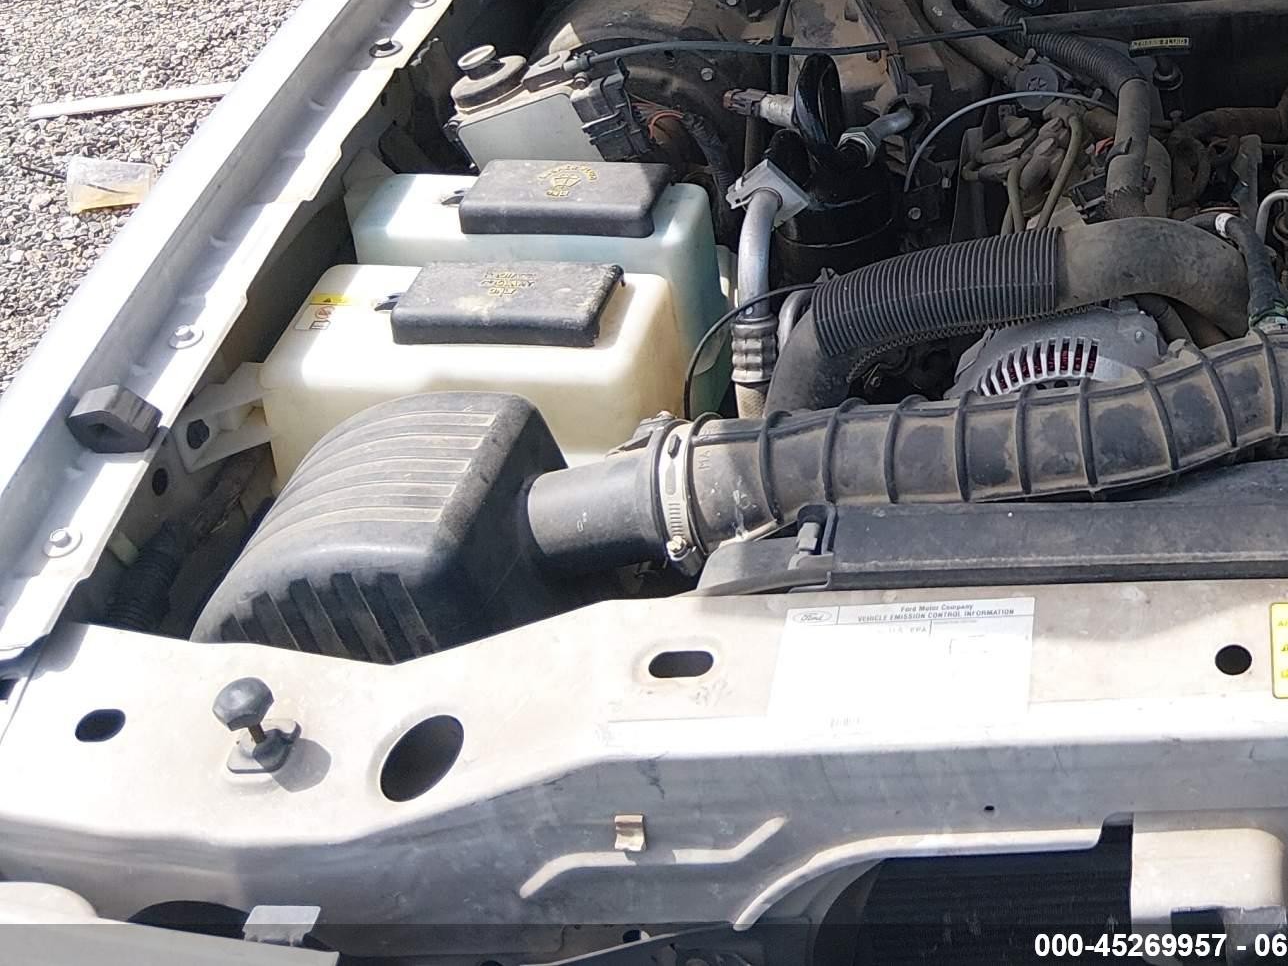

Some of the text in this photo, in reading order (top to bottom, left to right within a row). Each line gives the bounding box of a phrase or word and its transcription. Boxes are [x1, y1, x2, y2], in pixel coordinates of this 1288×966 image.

[941, 603, 974, 611] Company
[858, 609, 1015, 622] VEHICLE EMISSION CONTROL INFORMATION
